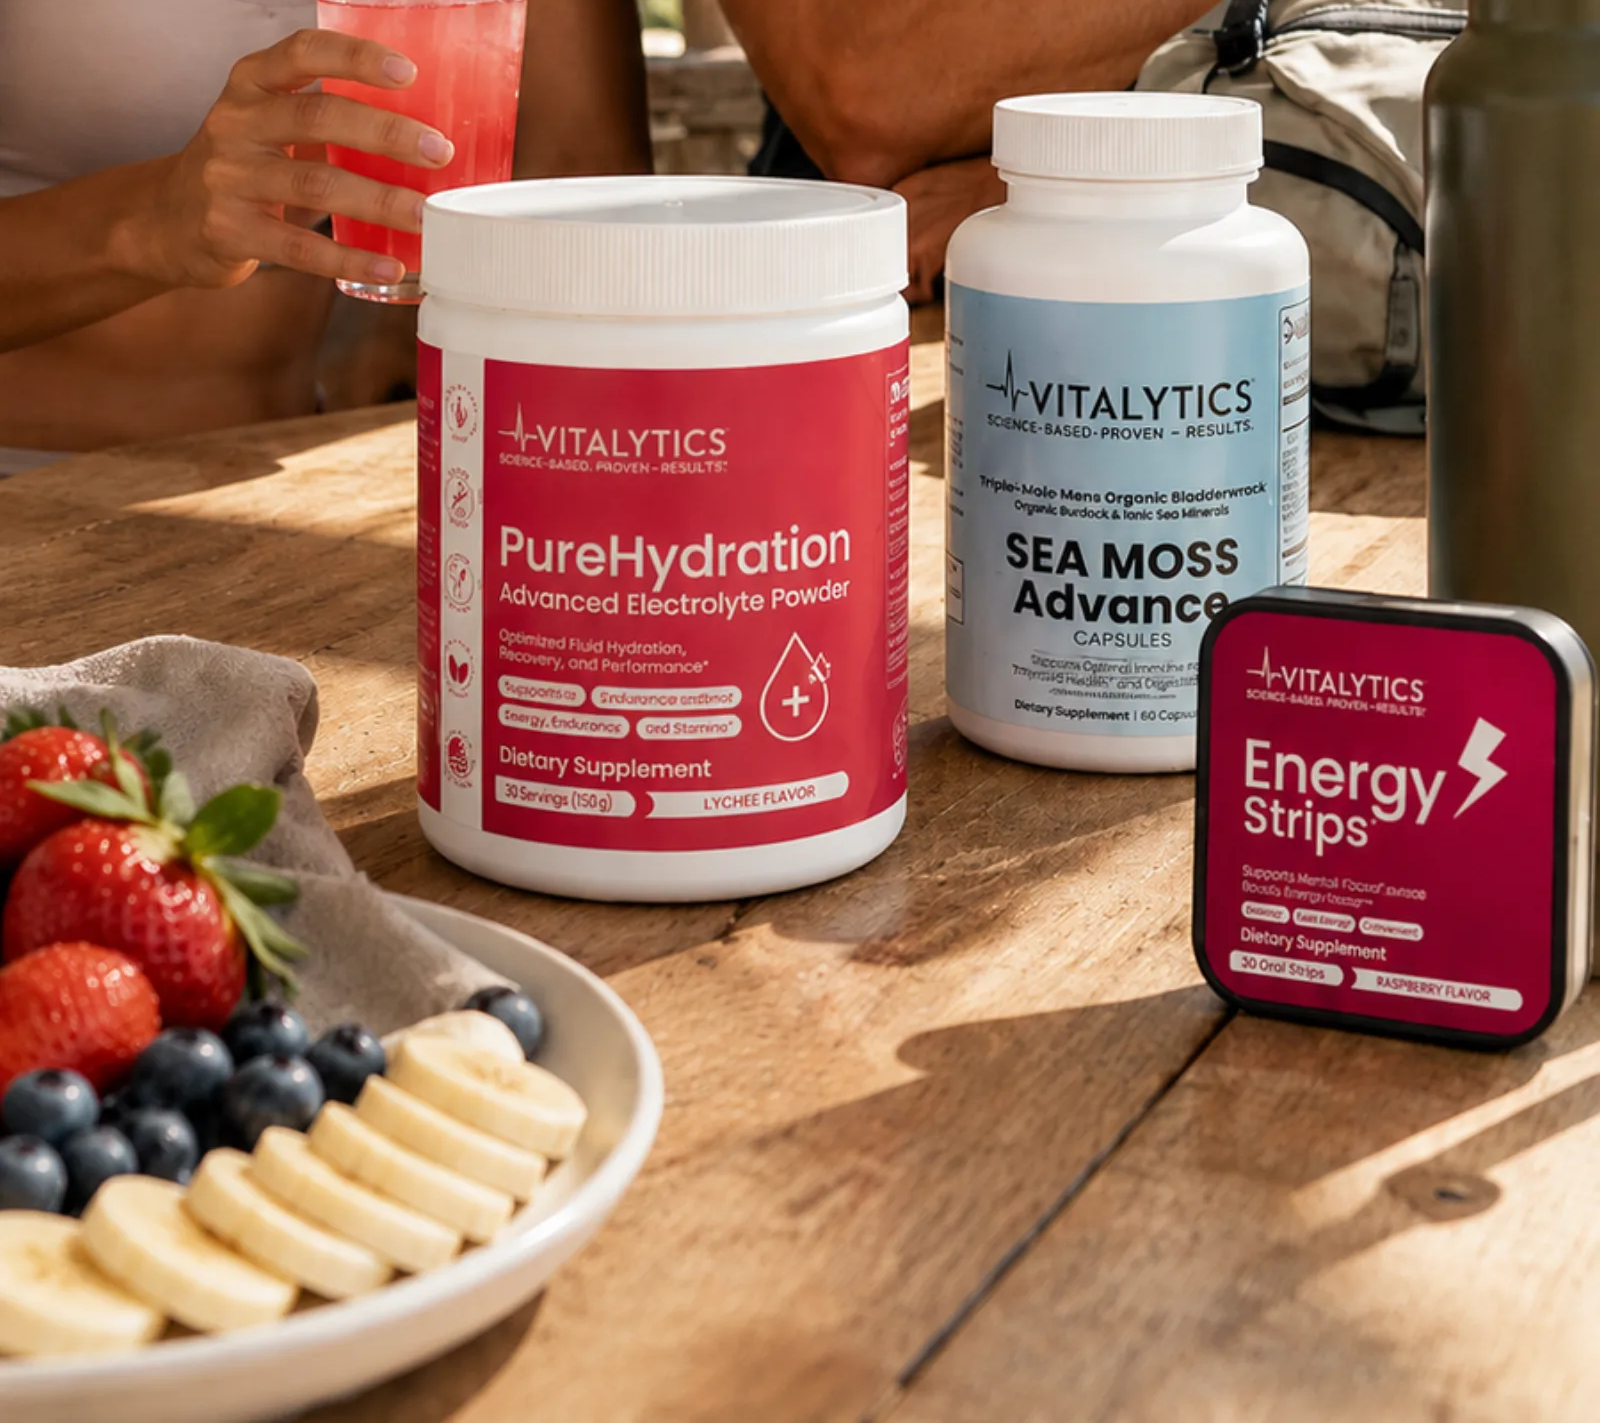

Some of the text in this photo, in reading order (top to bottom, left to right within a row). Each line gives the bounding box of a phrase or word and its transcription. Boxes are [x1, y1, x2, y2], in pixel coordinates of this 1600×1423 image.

[1029, 379, 1252, 421] VITALYTICS
[536, 423, 727, 458] VITALYTICS
[595, 460, 650, 474] PROVEN
[1014, 500, 1057, 517] Organic
[1060, 503, 1109, 520] Burdock
[1105, 490, 1168, 508] Organic
[500, 524, 850, 593] PureHydration
[1005, 532, 1239, 580] SEA MOSS
[499, 579, 850, 621] Advanced Electrolyte Powder
[499, 628, 686, 658] Optimized Fluid Hydration,
[1073, 630, 1172, 649] CAPSULES
[499, 646, 565, 671] Recovery,
[568, 657, 598, 672] and
[1280, 666, 1425, 703] VITALYTICS
[1014, 699, 1054, 717] Dietary
[1055, 705, 1131, 722] Supplement
[1141, 710, 1156, 721] 60
[500, 744, 568, 778] Dietary
[574, 756, 712, 782] Supplement
[505, 783, 518, 799] 30
[520, 785, 569, 809] Servings
[1244, 737, 1447, 826] Energy
[704, 784, 816, 812] LYCHEE FLAVOR
[1243, 795, 1369, 857] Strips
[1240, 926, 1387, 961] Dietary Supplement
[1260, 958, 1286, 972] Oral
[1288, 962, 1326, 980] Strips
[1376, 975, 1492, 1003] RASPBERRY FLAVOR
